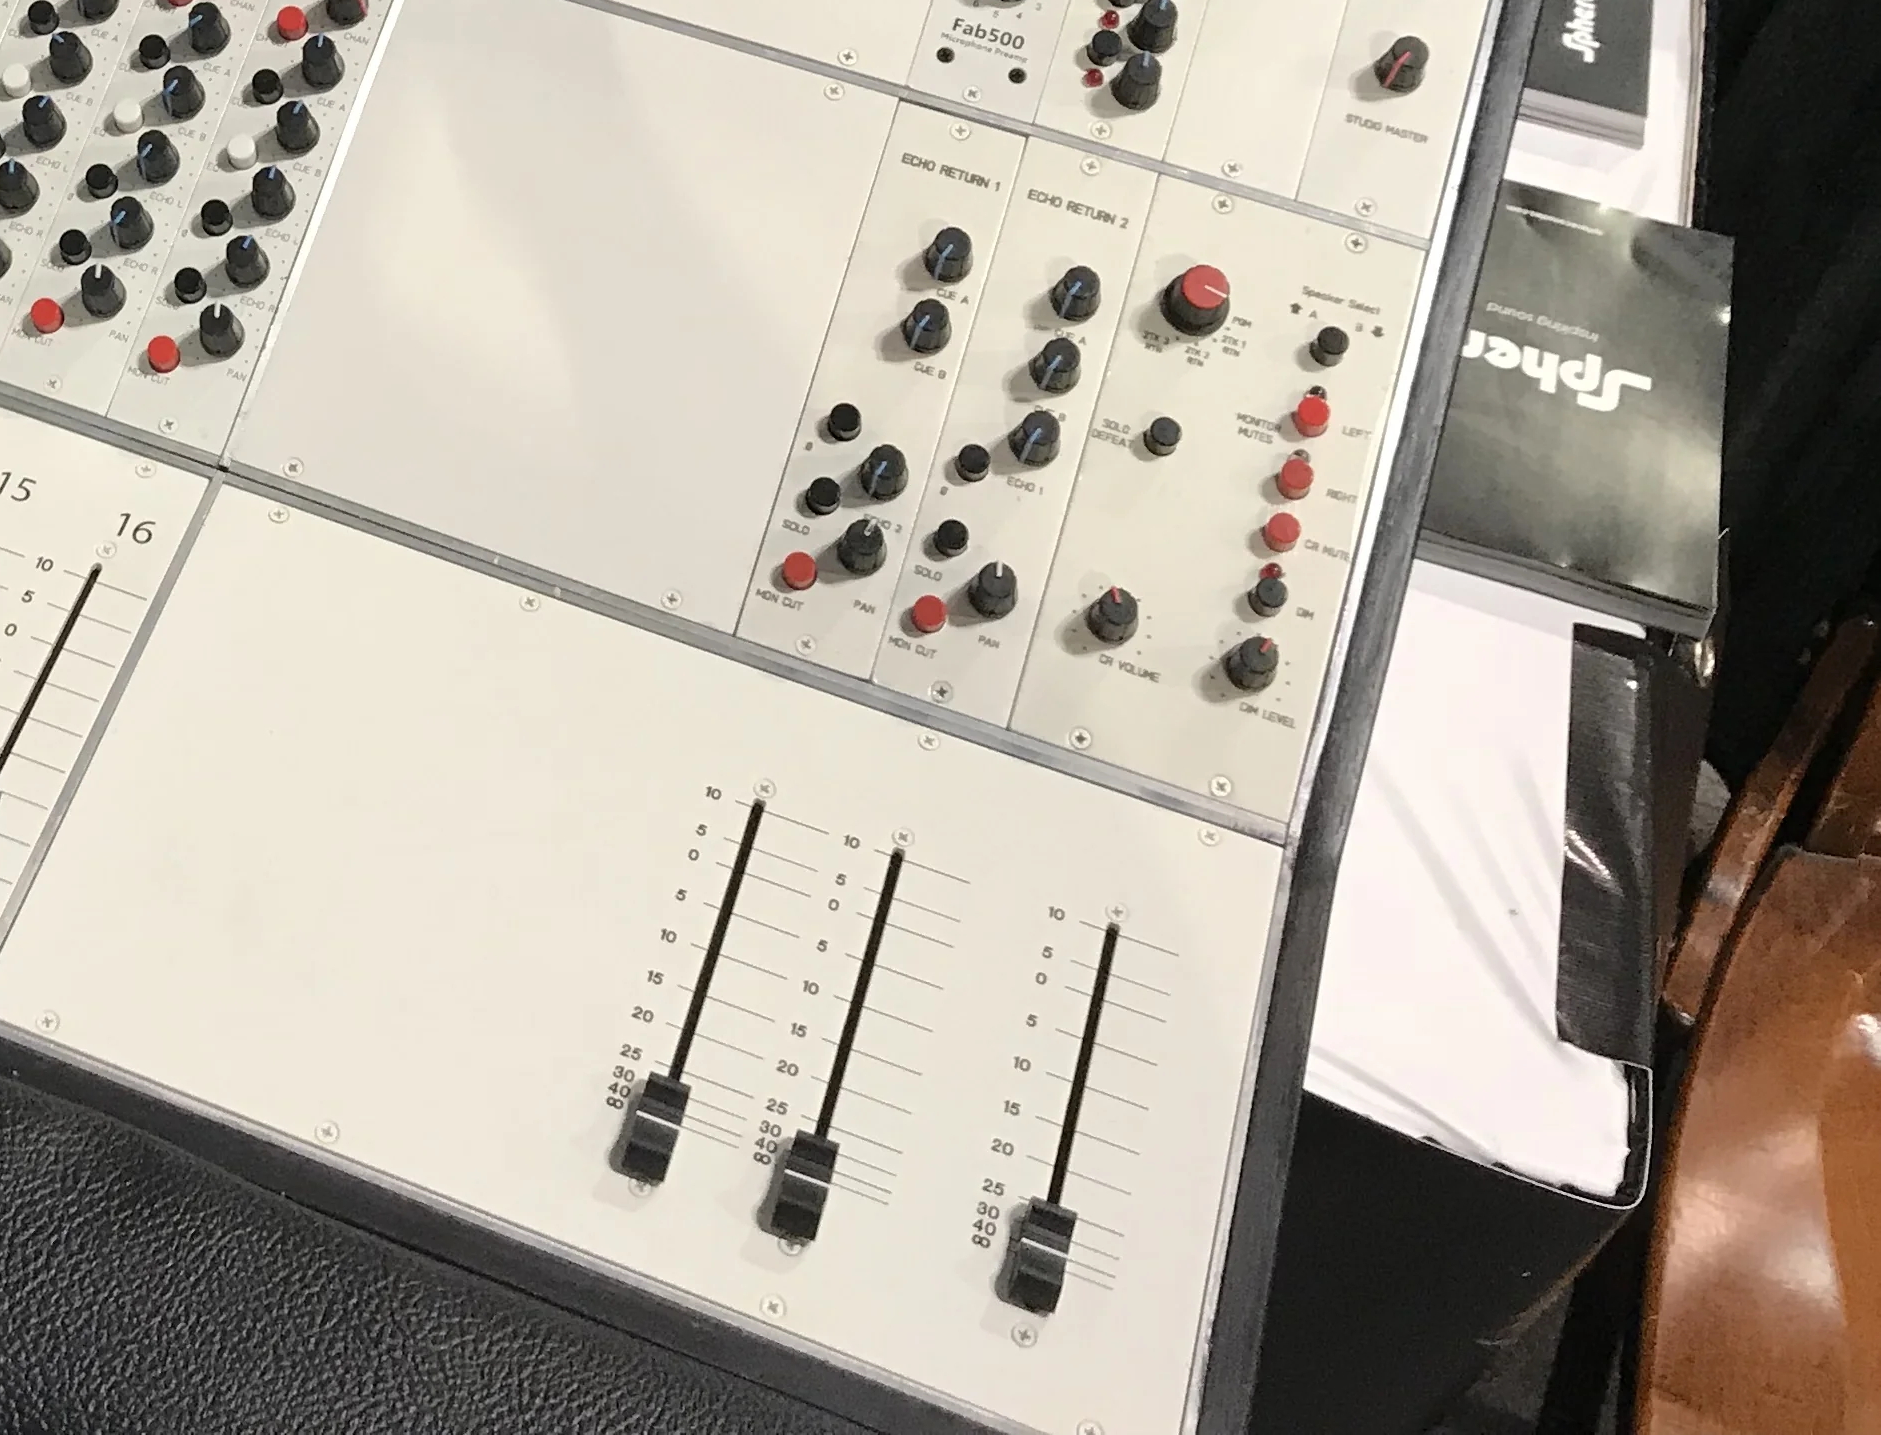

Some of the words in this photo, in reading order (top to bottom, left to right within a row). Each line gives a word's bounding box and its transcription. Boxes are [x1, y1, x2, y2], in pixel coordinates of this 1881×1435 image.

[952, 17, 1025, 50] Fab500
[1345, 113, 1382, 131] STUDIO
[1385, 125, 1428, 143] MASTER
[901, 153, 936, 171] ECHO
[939, 165, 990, 188] RETURN
[995, 182, 1000, 191] 1
[1027, 189, 1063, 208] ECHO
[1066, 201, 1117, 224] RETURN
[1120, 218, 1129, 229] 2
[936, 286, 957, 300] CUE
[960, 296, 969, 304] A
[1302, 286, 1345, 304] Speaker
[1348, 299, 1380, 315] Select
[1486, 302, 1534, 323] sound
[914, 362, 935, 376] CUE
[938, 370, 947, 379] B
[1461, 329, 1652, 412] Spher
[1102, 419, 1131, 434] SOLO
[1342, 426, 1372, 440] LEFT
[1091, 428, 1134, 450] DEFEAT
[1238, 427, 1273, 444] MUTES
[1006, 475, 1035, 492] ECHO
[1039, 487, 1043, 495] 1
[1326, 489, 1358, 504] RIGHT
[117, 513, 155, 544] 16
[782, 519, 810, 535] SOLO
[914, 565, 942, 581] SOLO
[755, 588, 779, 603] MON
[782, 597, 804, 610] CUT
[853, 600, 875, 614] PAN
[888, 635, 911, 650] MON
[915, 645, 937, 659] CUT
[978, 635, 1000, 648] PAN
[1099, 654, 1114, 666] CR
[1119, 660, 1160, 683] VOLUME
[1239, 702, 1259, 715] DIM
[1262, 710, 1295, 729] LEVEL
[706, 786, 721, 800] 10
[696, 824, 707, 836] 5
[688, 849, 699, 861] 0
[676, 889, 687, 901] 5
[661, 929, 677, 943] 10
[648, 970, 664, 985] 15
[632, 1006, 654, 1023] 20
[620, 1044, 642, 1060] 25
[613, 1066, 635, 1084] 30
[607, 1081, 631, 1098] 40
